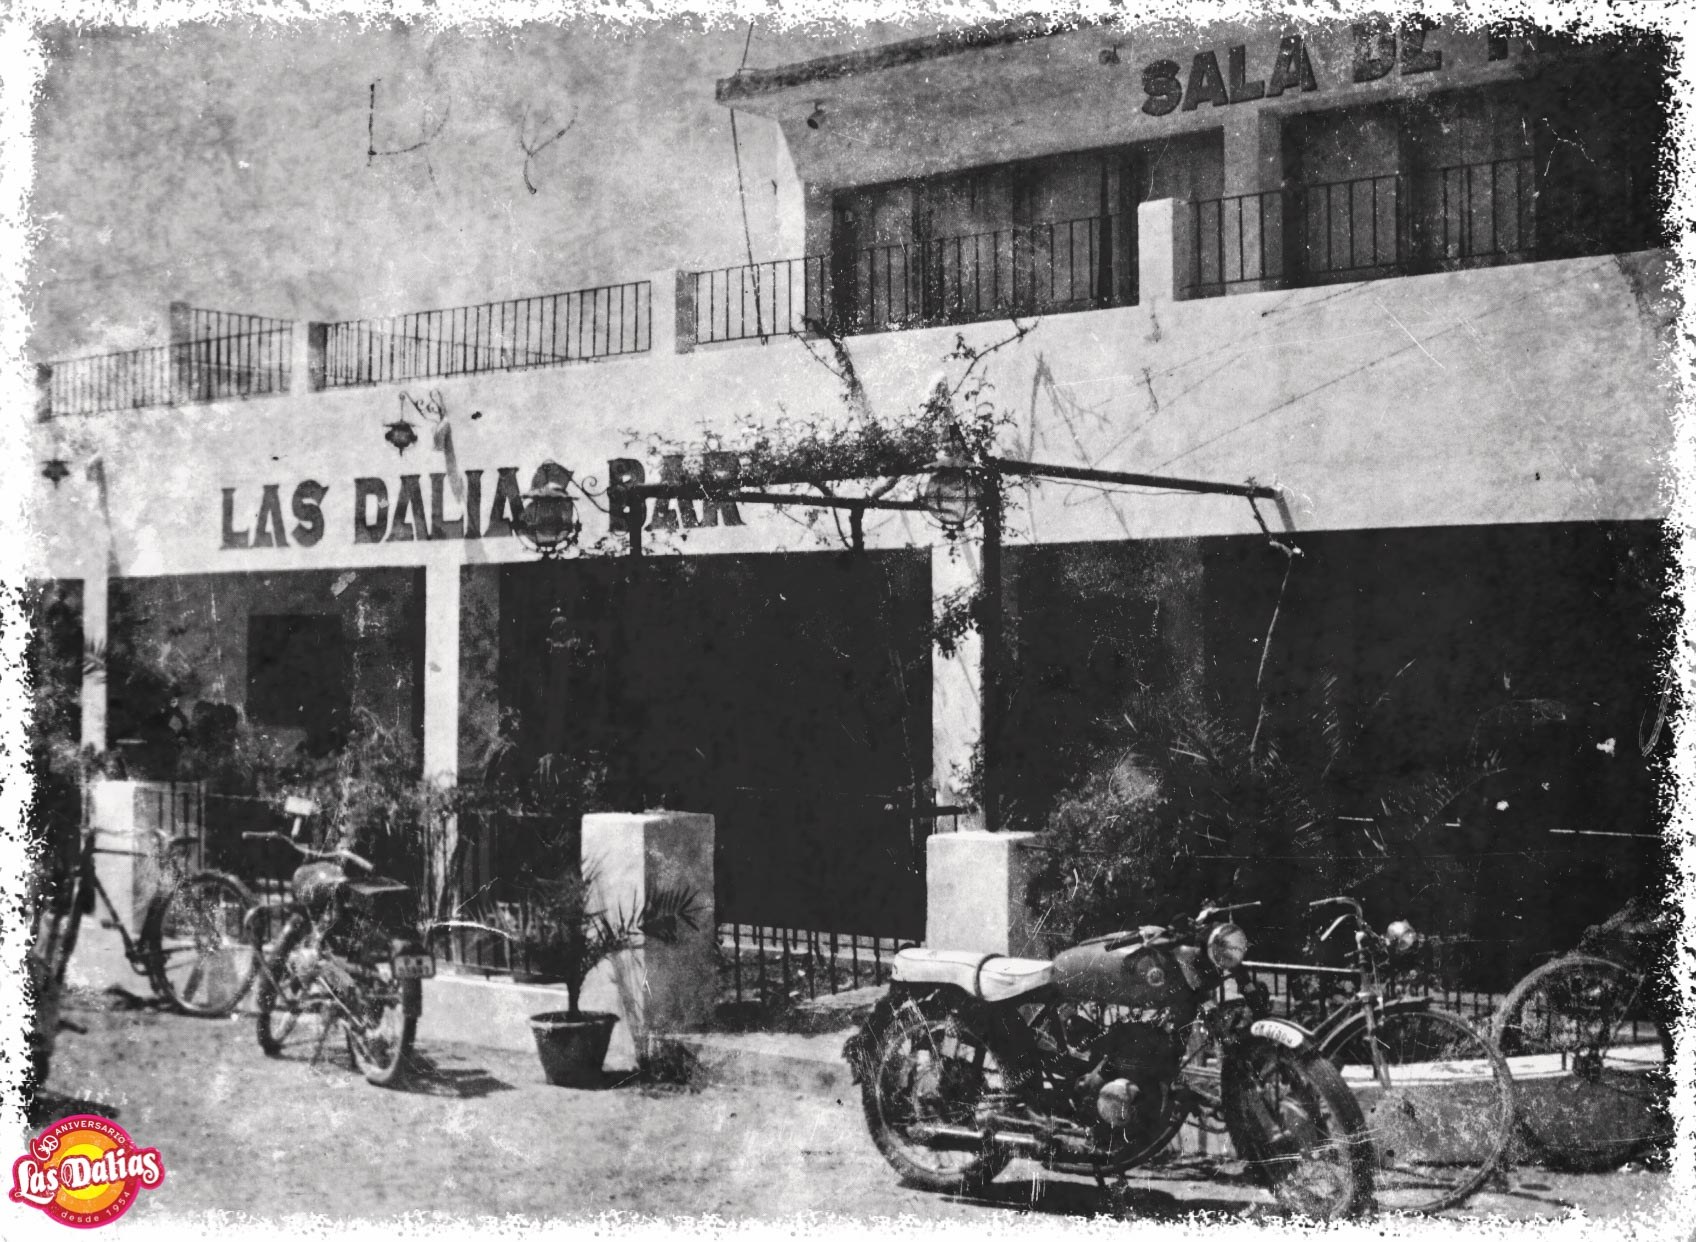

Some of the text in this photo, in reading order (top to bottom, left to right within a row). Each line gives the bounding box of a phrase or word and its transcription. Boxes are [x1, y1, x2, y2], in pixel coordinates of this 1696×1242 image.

[1141, 34, 1318, 116] SALA
[1351, 13, 1443, 83] DE
[219, 479, 330, 550] LAS
[606, 449, 747, 533] BAR
